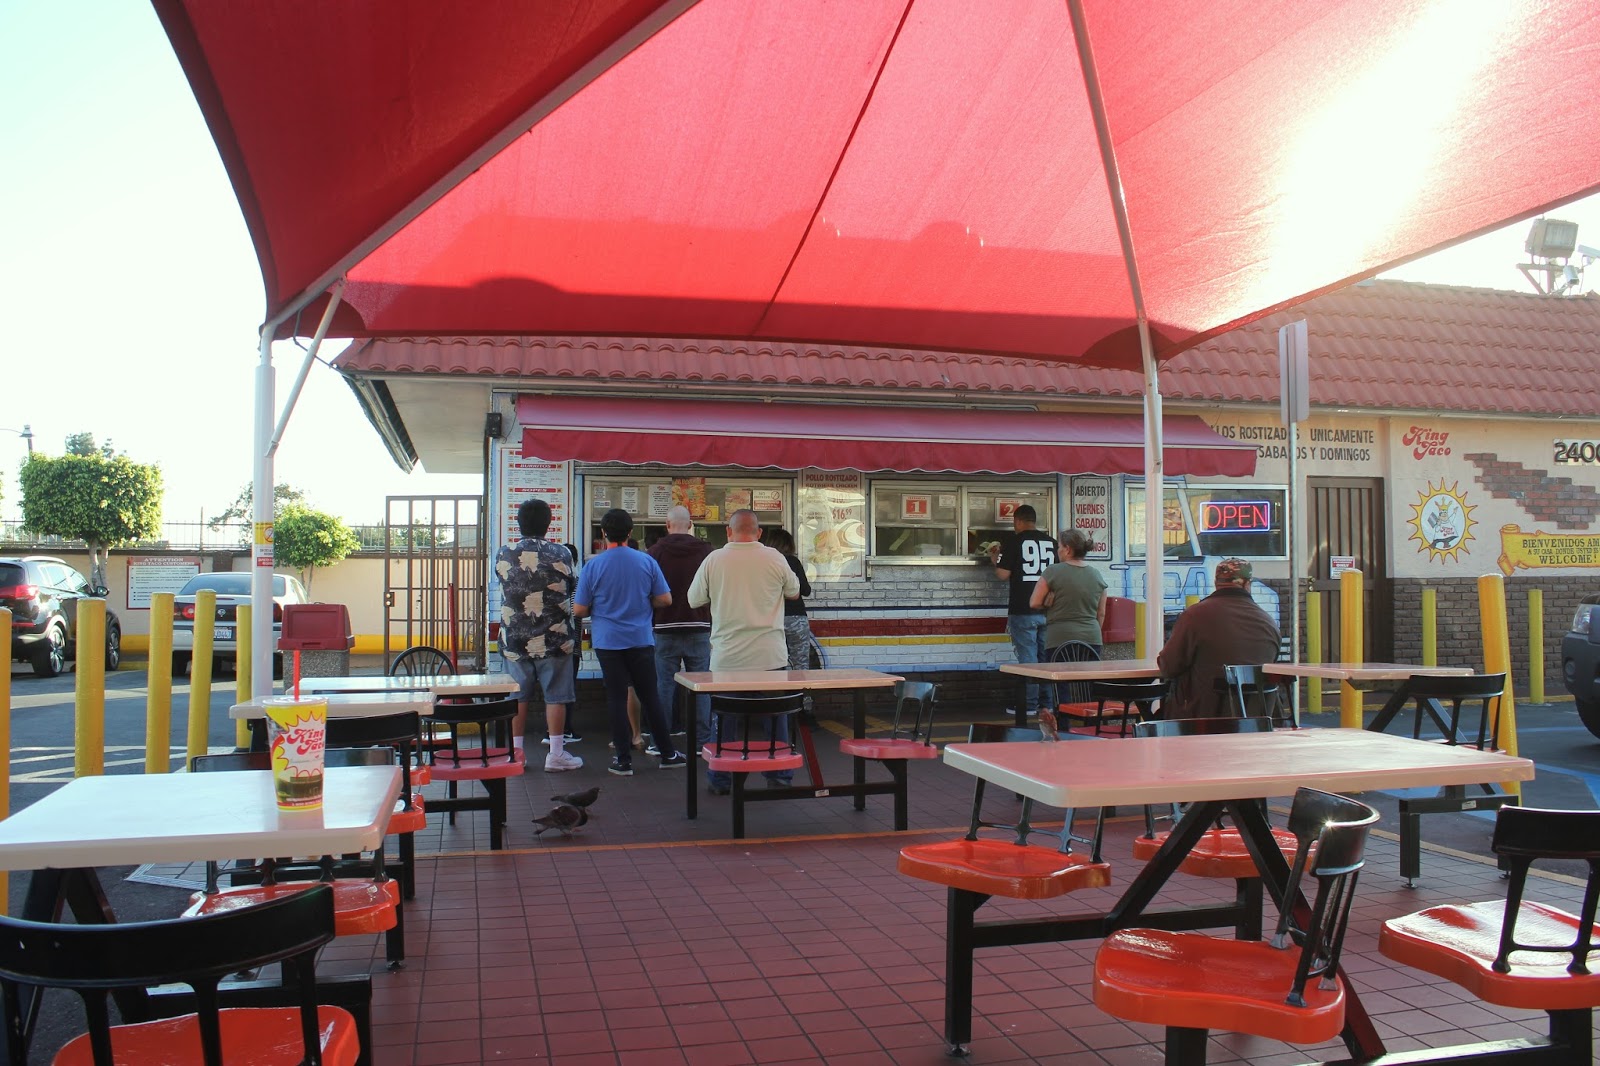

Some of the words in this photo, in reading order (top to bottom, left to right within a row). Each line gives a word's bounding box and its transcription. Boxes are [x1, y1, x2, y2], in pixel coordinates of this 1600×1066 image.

[1310, 428, 1374, 443] UNICAMENTE
[1402, 426, 1449, 446] King
[1258, 446, 1307, 460] SABAOS
[1310, 447, 1317, 460] Y
[1320, 447, 1371, 461] DOMINGOS
[1413, 441, 1451, 460] Taco
[826, 474, 858, 482] ROSTIZADO
[1075, 486, 1106, 496] ABIERTO
[912, 501, 921, 513] 1
[1005, 504, 1014, 516] 2
[1075, 504, 1105, 514] VIERNES
[1203, 504, 1268, 529] OPEN
[1076, 518, 1107, 529] SABADO
[1522, 538, 1585, 548] BIENVENIDOS
[1021, 540, 1055, 574] 95
[1539, 554, 1597, 565] WELCOME!
[287, 729, 325, 745] King
